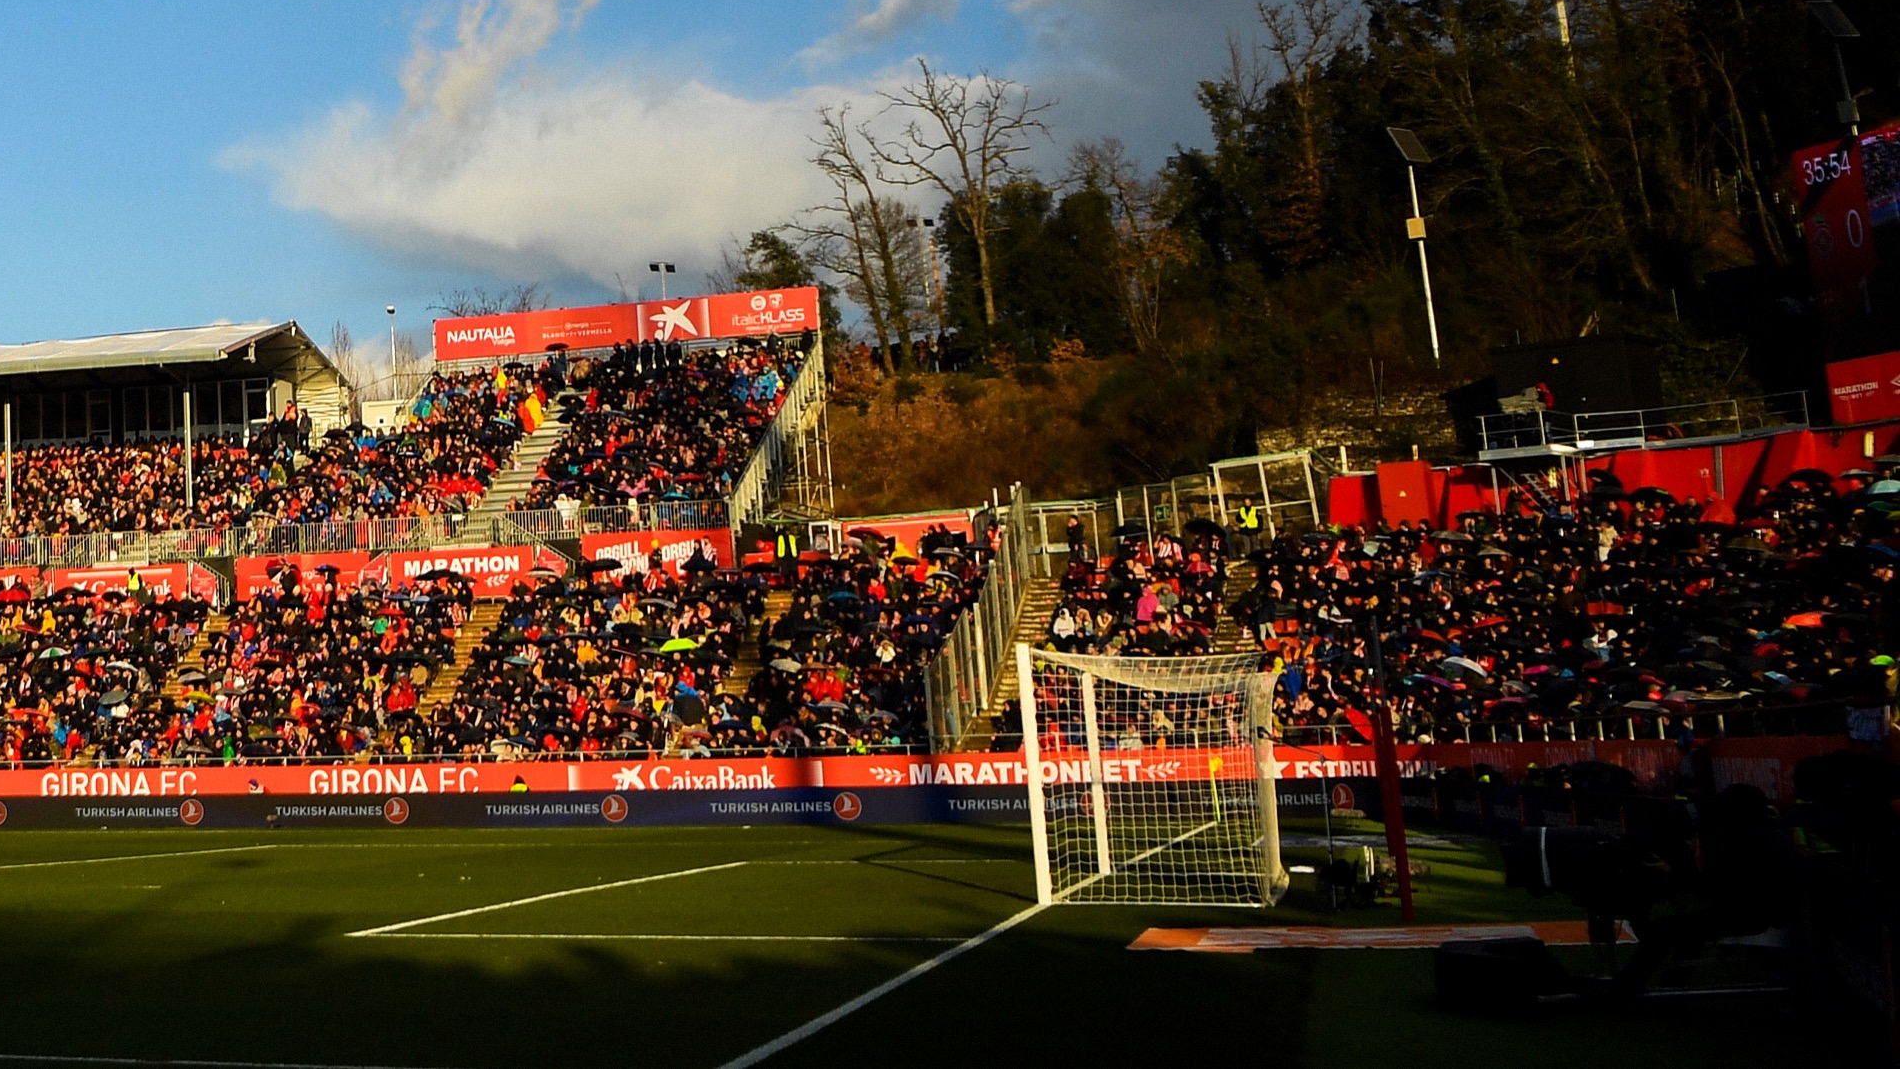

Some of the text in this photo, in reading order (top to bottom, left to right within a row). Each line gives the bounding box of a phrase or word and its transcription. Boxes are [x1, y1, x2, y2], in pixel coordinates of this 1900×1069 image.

[1803, 150, 1852, 185] 35:54
[732, 308, 805, 326] italicKLASS
[447, 326, 515, 344] NAUTALIA
[1833, 381, 1879, 395] MARATHON
[404, 555, 520, 576] MARATHON
[41, 771, 196, 797] GIRONA FC
[309, 767, 479, 794] GIRONA FC
[650, 765, 776, 790] CaixaBank
[75, 807, 179, 818] TURKISH AIRLINES
[275, 805, 383, 817] TURKISH AIRLINES
[486, 804, 600, 815] TURKISH AIRLINES
[710, 802, 832, 813] TURKISH AIRLINES
[948, 799, 1010, 811] TURKISH
